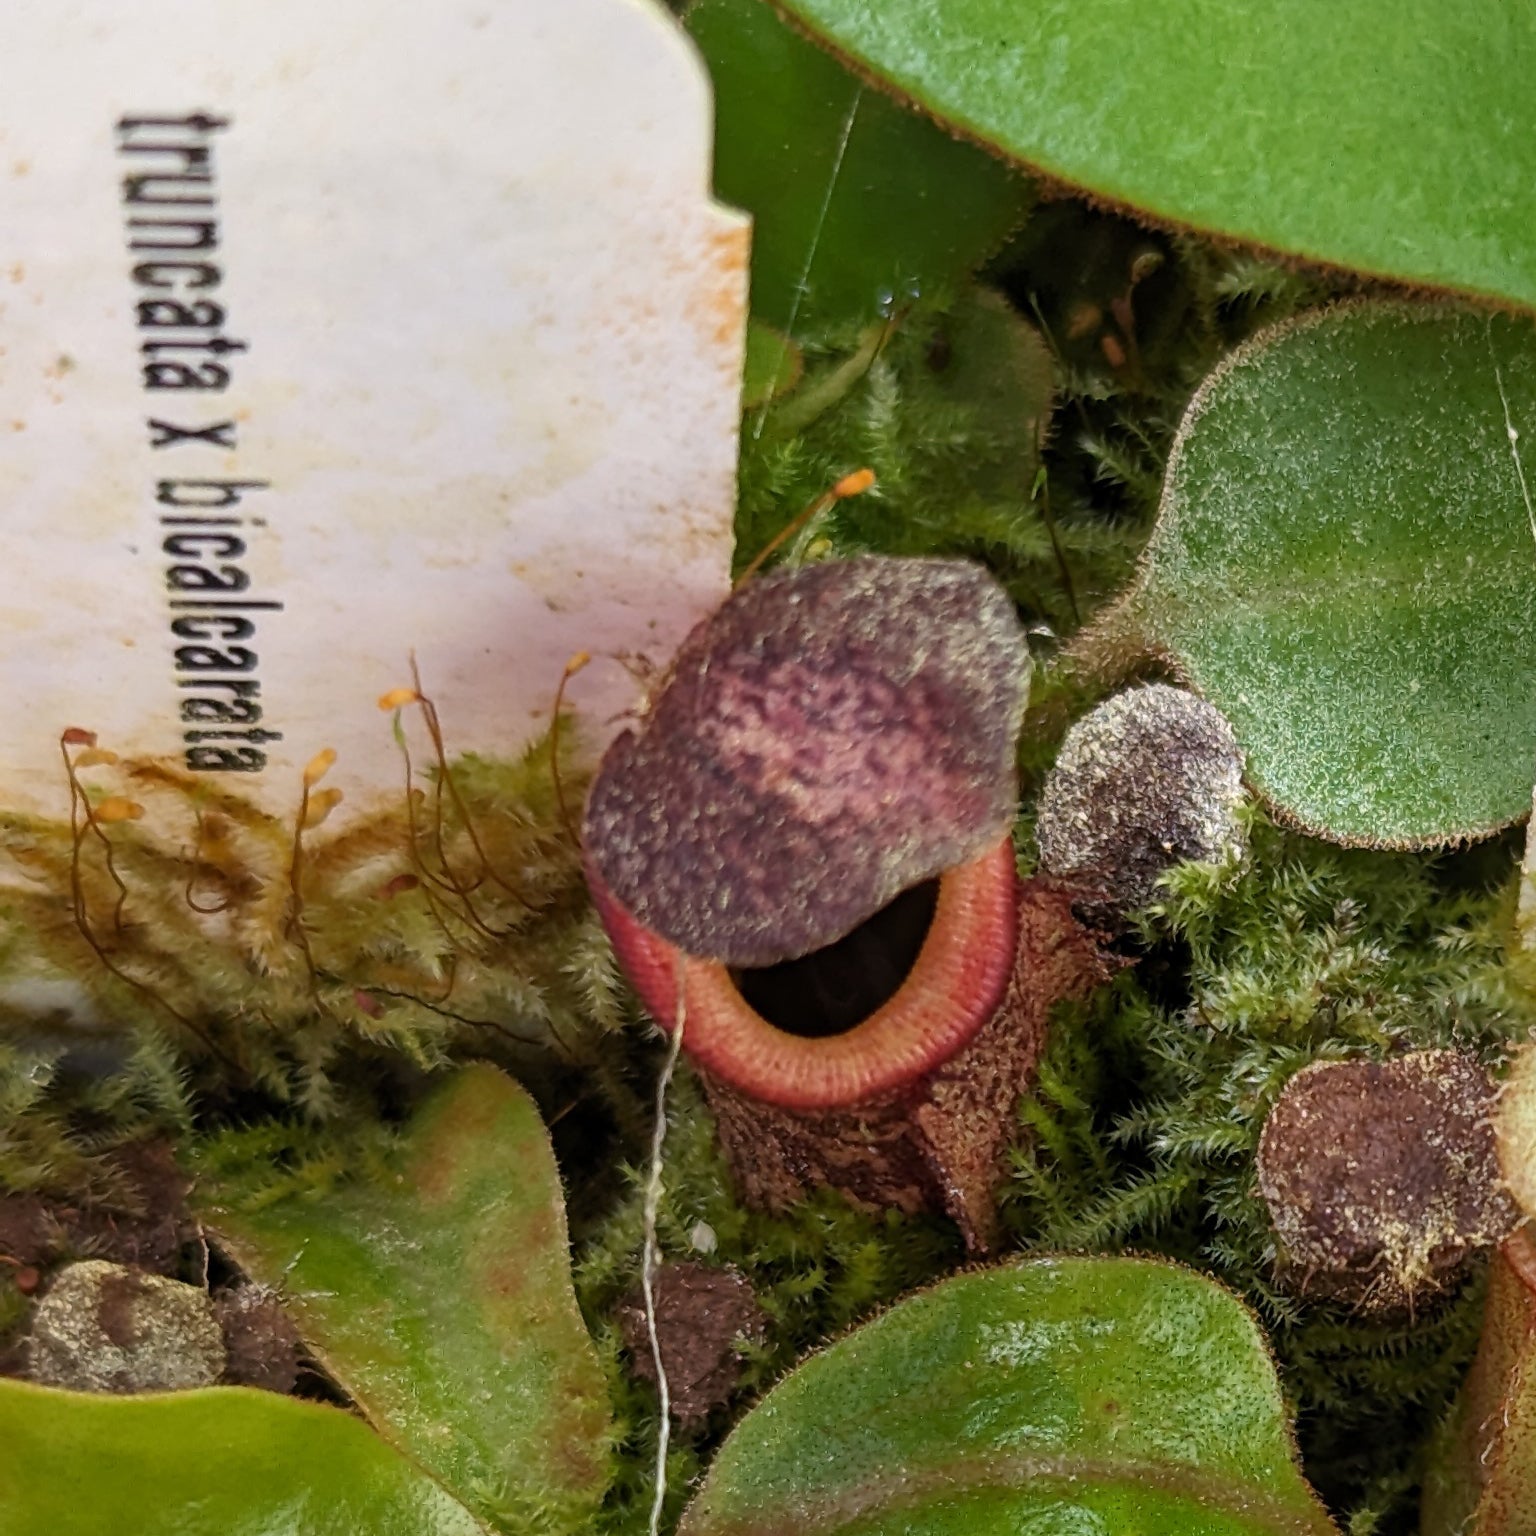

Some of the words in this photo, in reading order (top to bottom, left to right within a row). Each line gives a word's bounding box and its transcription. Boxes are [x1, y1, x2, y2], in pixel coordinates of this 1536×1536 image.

[113, 108, 249, 393] truncata
[145, 416, 238, 450] x
[155, 477, 284, 773] bicalcarata
